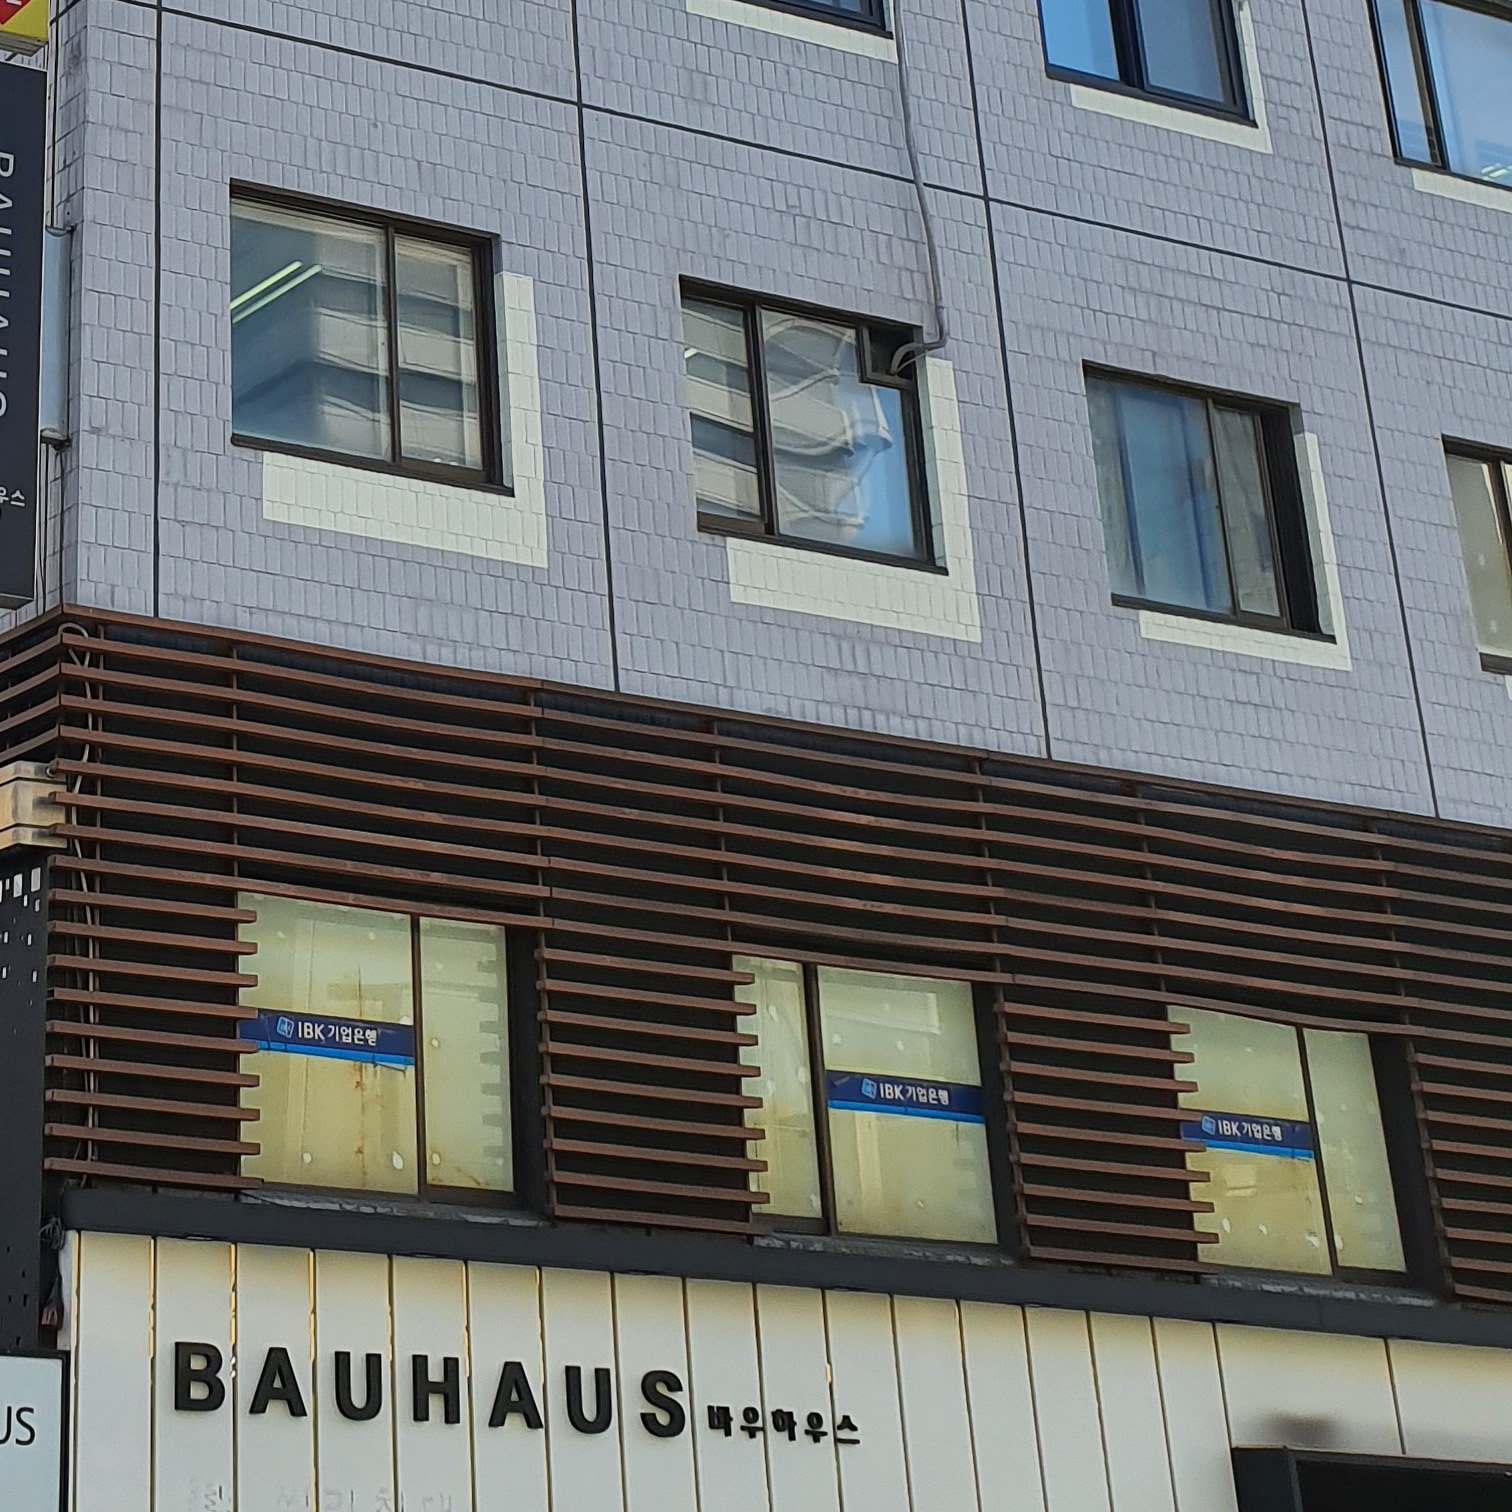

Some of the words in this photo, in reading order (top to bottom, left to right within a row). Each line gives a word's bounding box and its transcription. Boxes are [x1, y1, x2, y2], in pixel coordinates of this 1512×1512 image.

[298, 1021, 325, 1041] IBK
[879, 1082, 905, 1101] IBK
[1217, 1119, 1242, 1137] IBK
[173, 1340, 686, 1439] BAUHAUS
[706, 1405, 861, 1445] 바우하우스
